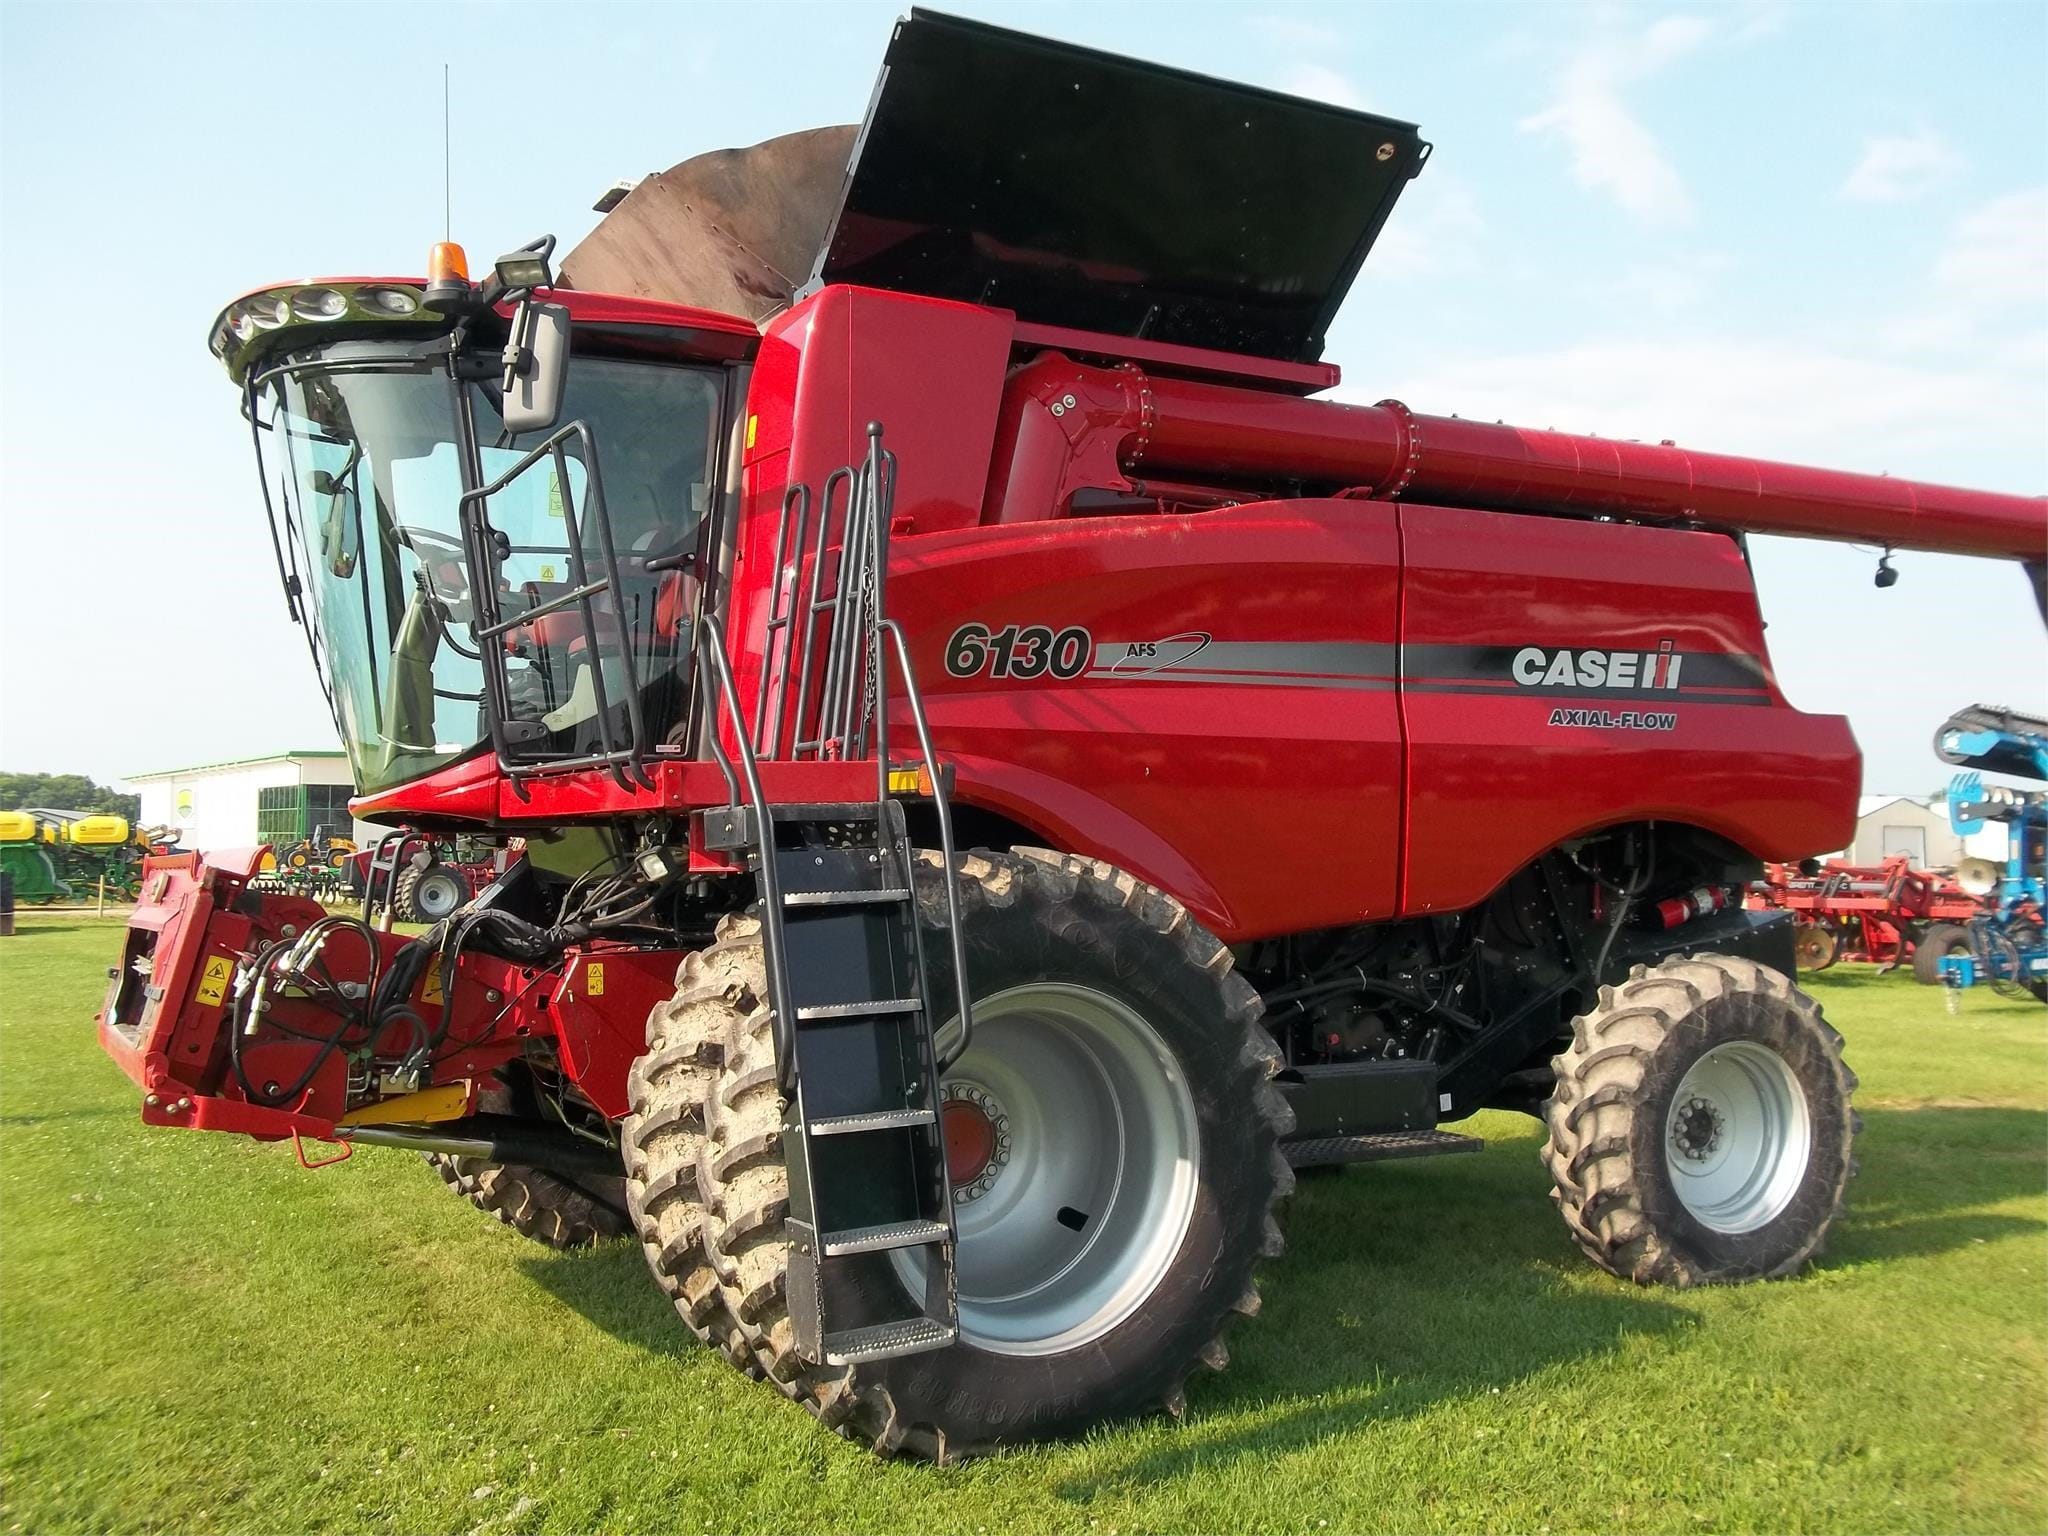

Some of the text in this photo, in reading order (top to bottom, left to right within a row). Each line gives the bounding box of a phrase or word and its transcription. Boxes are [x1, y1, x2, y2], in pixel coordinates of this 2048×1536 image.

[944, 622, 1091, 680] 6130
[1127, 643, 1157, 657] AFS
[1512, 648, 1638, 688] CASE
[1548, 709, 1677, 729] AXIAL-FLOW
